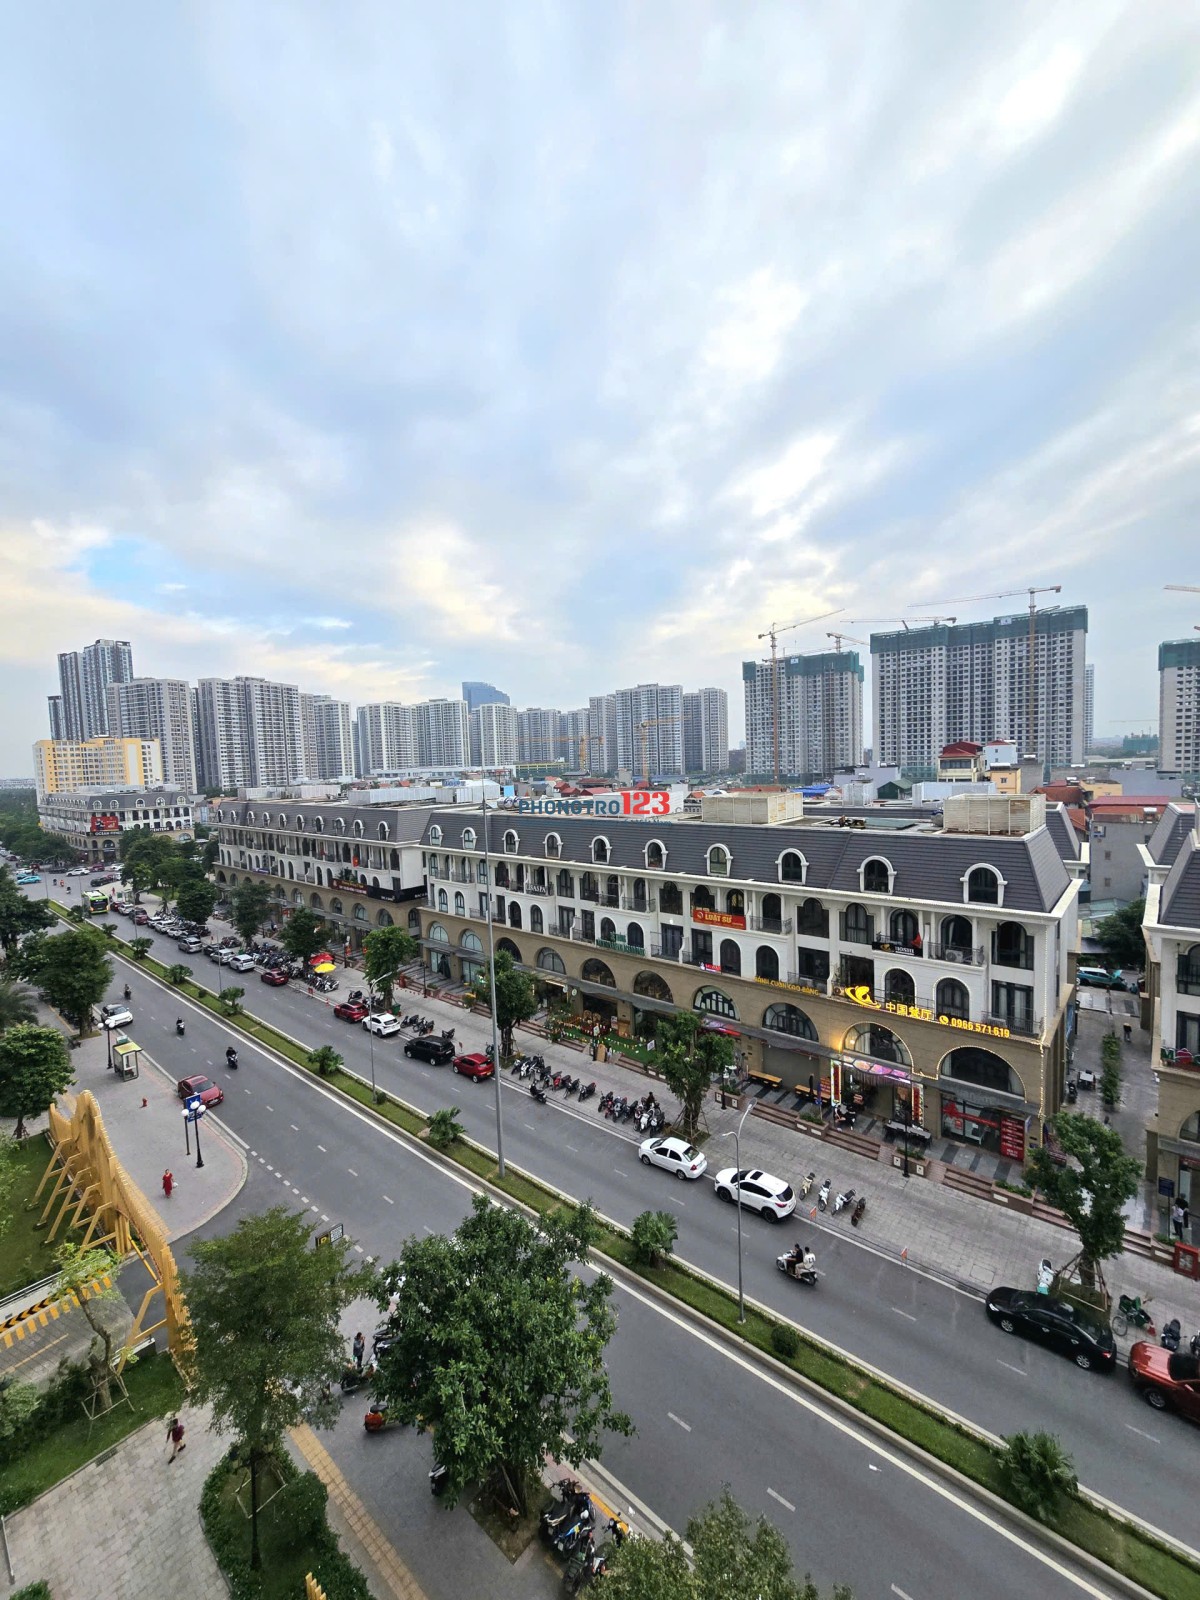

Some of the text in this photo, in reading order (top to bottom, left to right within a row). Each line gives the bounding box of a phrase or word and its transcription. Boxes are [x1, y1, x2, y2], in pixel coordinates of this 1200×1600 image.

[886, 1001, 933, 1020] 中国餐厅
[951, 1017, 1010, 1039] 0966 571 619
